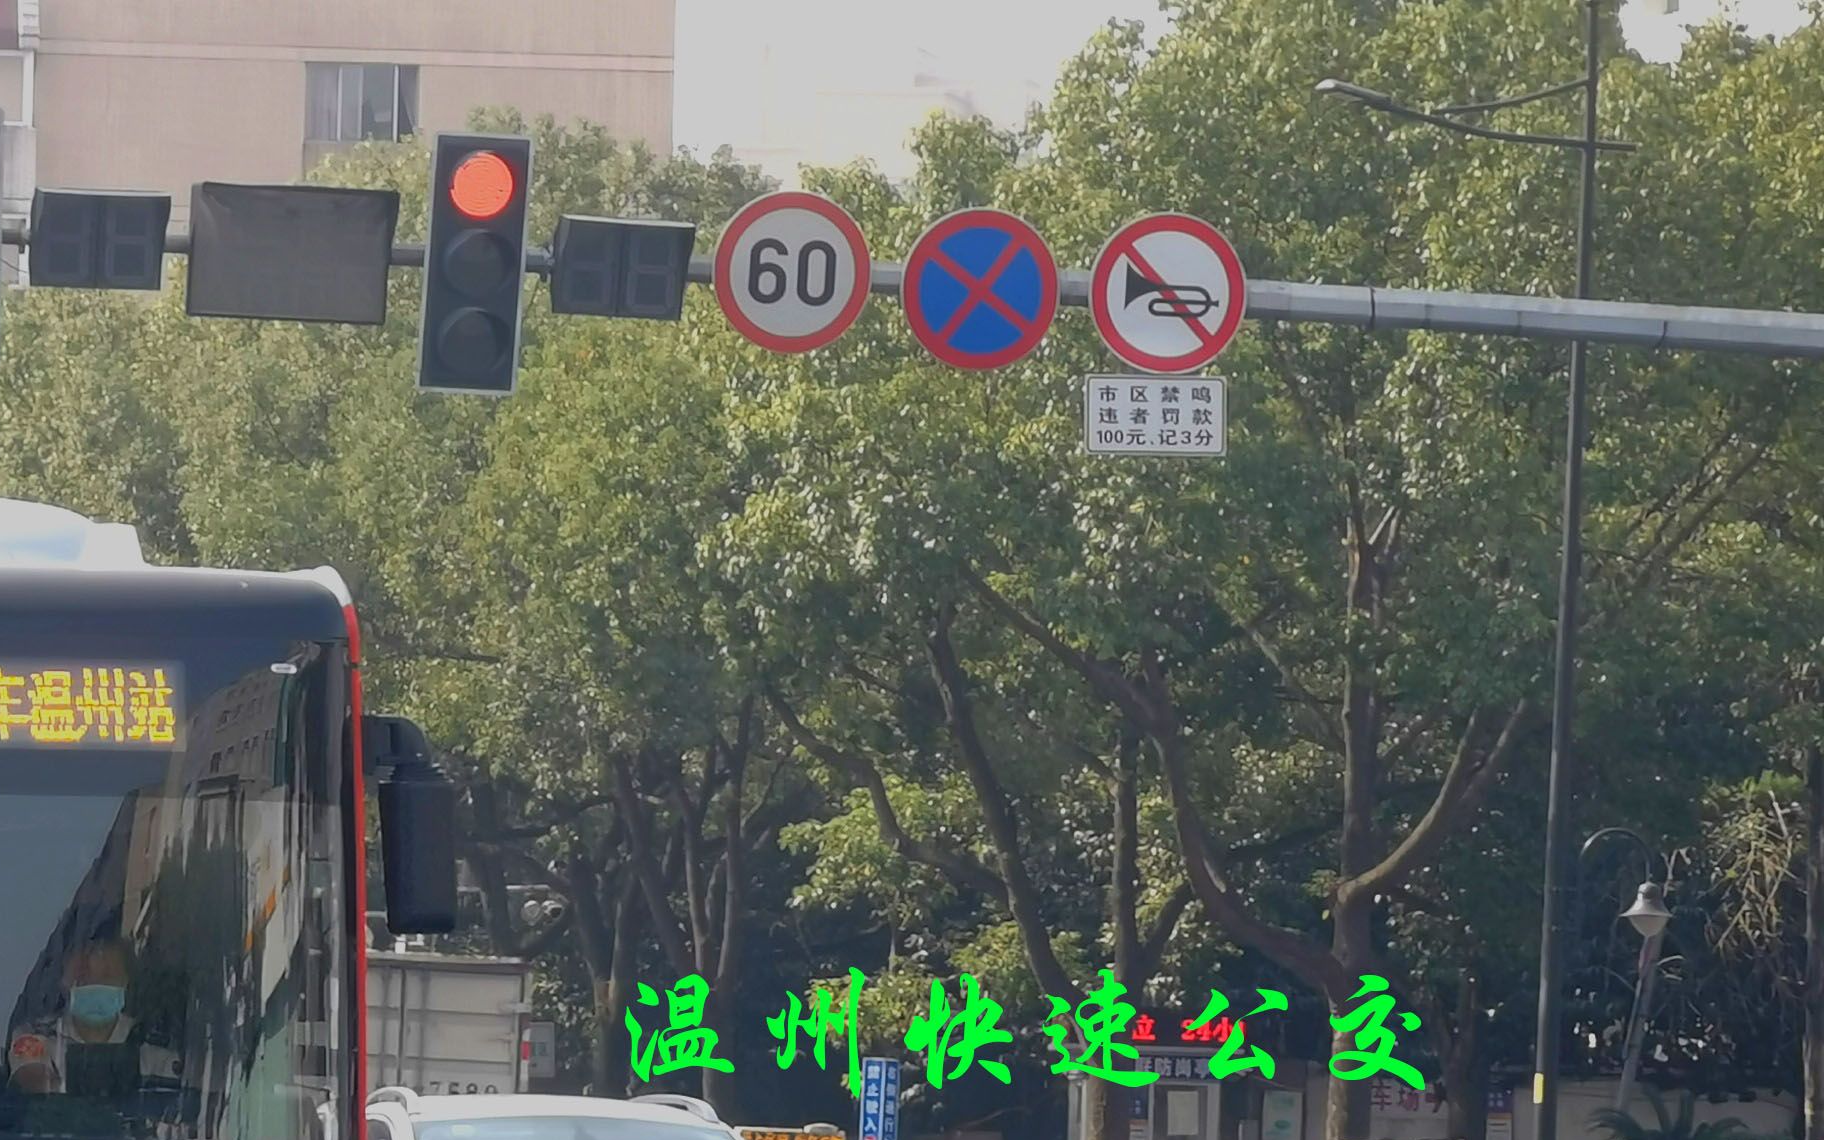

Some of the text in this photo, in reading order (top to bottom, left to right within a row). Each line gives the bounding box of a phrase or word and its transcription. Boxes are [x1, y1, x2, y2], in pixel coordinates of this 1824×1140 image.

[747, 237, 837, 307] 60
[1098, 385, 1211, 403] 市区禁鸣
[1098, 406, 1212, 425] 违者罚款
